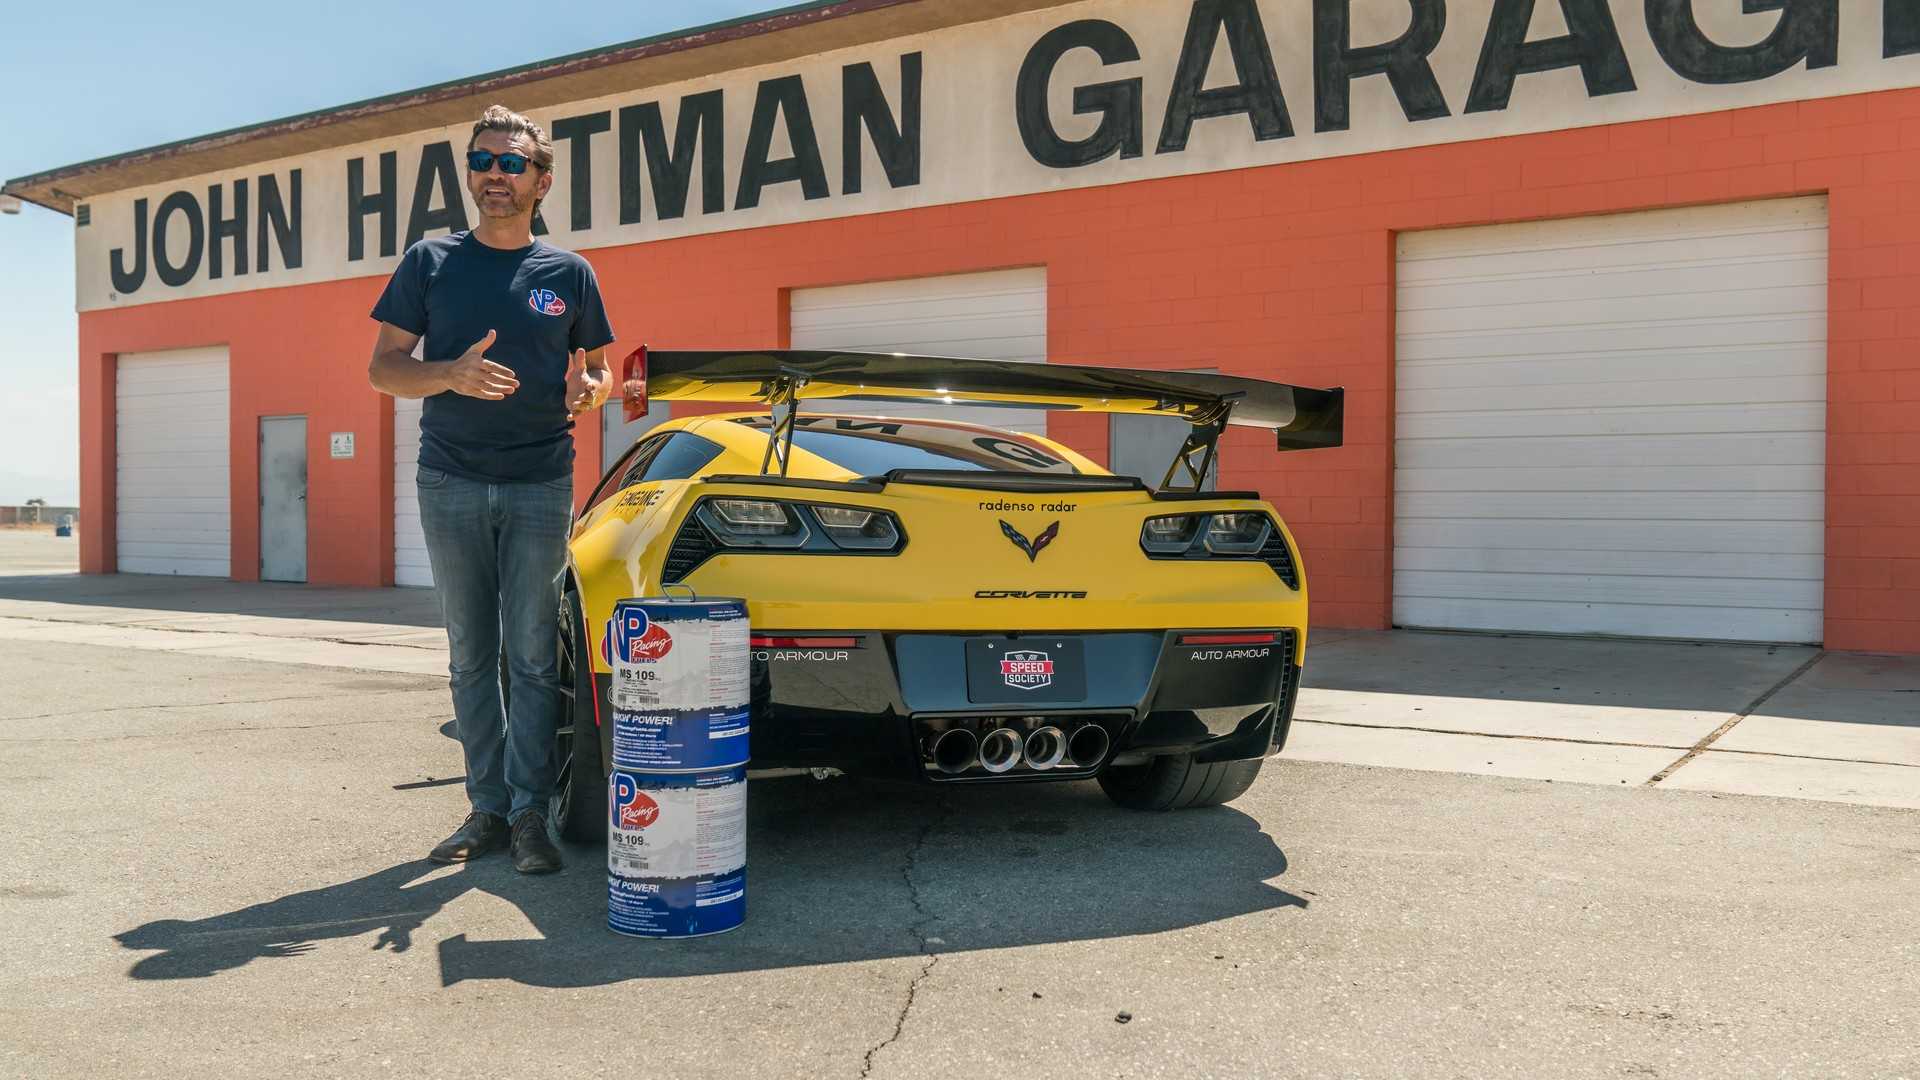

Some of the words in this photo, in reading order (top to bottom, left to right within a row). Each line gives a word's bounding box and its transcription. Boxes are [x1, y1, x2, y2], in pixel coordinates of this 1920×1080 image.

[110, 168, 302, 294] JOHN
[347, 51, 922, 262] HATMAN
[530, 288, 557, 314] VP
[979, 498, 1035, 512] radenso
[1041, 499, 1077, 512] radar
[974, 590, 1088, 599] CORVETTE
[631, 637, 672, 656] Racing
[774, 651, 849, 661] ARMOUR
[1191, 650, 1223, 660] AUTO
[1225, 648, 1270, 659] ARMOUR
[1010, 662, 1045, 673] SPEED
[619, 668, 632, 679] MS
[634, 670, 655, 681] 109
[1008, 674, 1047, 683] SOCIETY
[631, 714, 673, 725] POWER!
[621, 806, 660, 823] Racing
[624, 834, 644, 846] 109
[621, 880, 660, 893] POWER!
